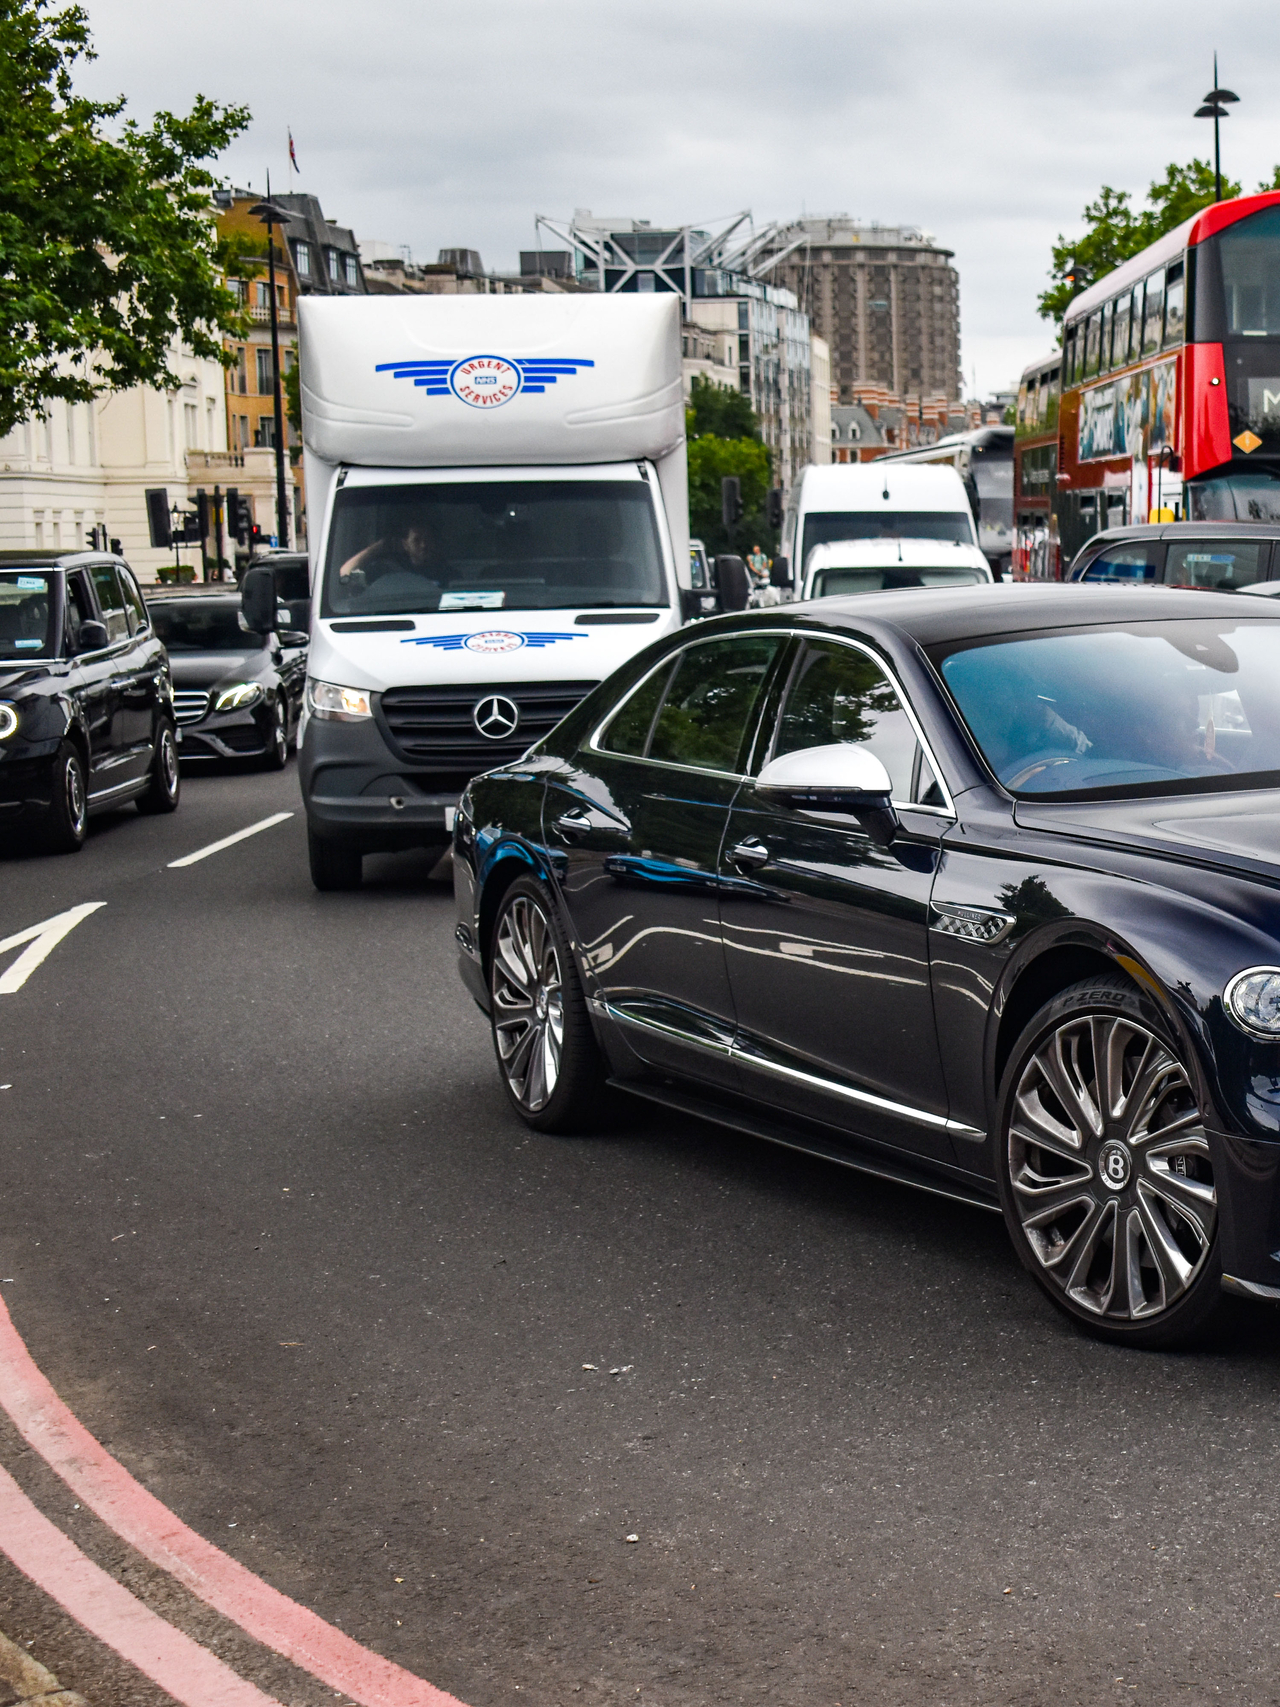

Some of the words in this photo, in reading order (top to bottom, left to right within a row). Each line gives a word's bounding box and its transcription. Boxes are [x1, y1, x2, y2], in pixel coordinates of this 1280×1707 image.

[460, 360, 511, 375] URGENT
[475, 377, 497, 385] NHS
[459, 385, 513, 405] SERVICES
[1078, 991, 1127, 1002] ZERO
[1108, 1155, 1125, 1179] B
